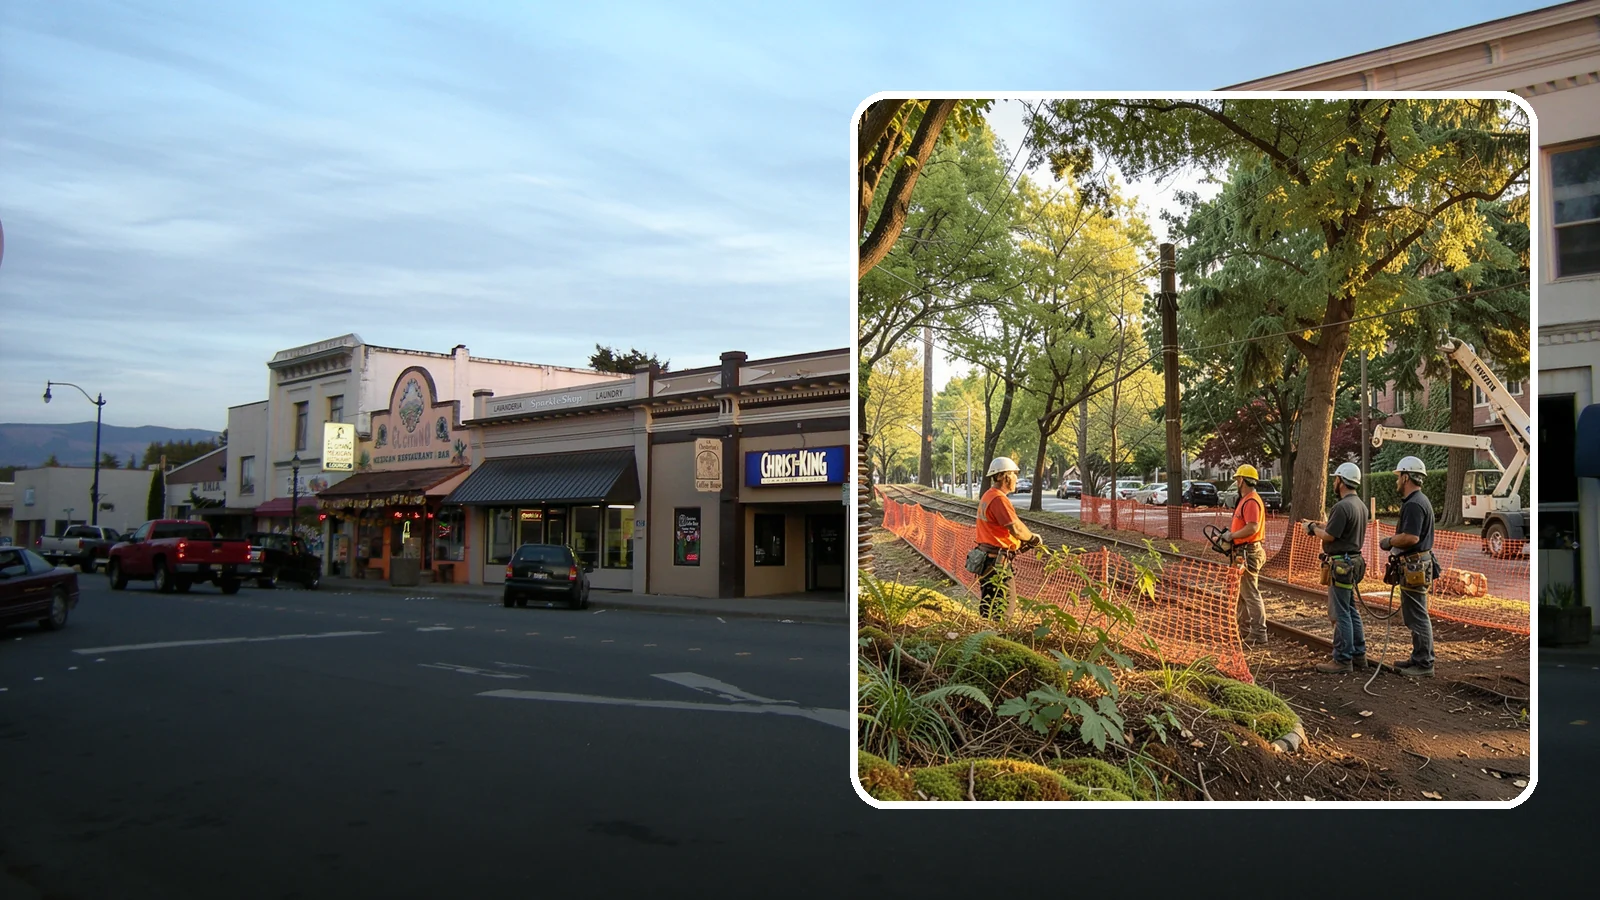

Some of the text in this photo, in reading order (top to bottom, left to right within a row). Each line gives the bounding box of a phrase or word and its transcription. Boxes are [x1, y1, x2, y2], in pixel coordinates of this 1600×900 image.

[530, 394, 582, 409] Sparkle Shop
[595, 389, 623, 400] LAUNDRY
[493, 402, 522, 412] LAVANDERIA
[373, 455, 396, 464] MEXICAN
[397, 451, 433, 462] RESTAURANT
[437, 450, 450, 459] BAR
[761, 450, 827, 477] CHRIST KING
